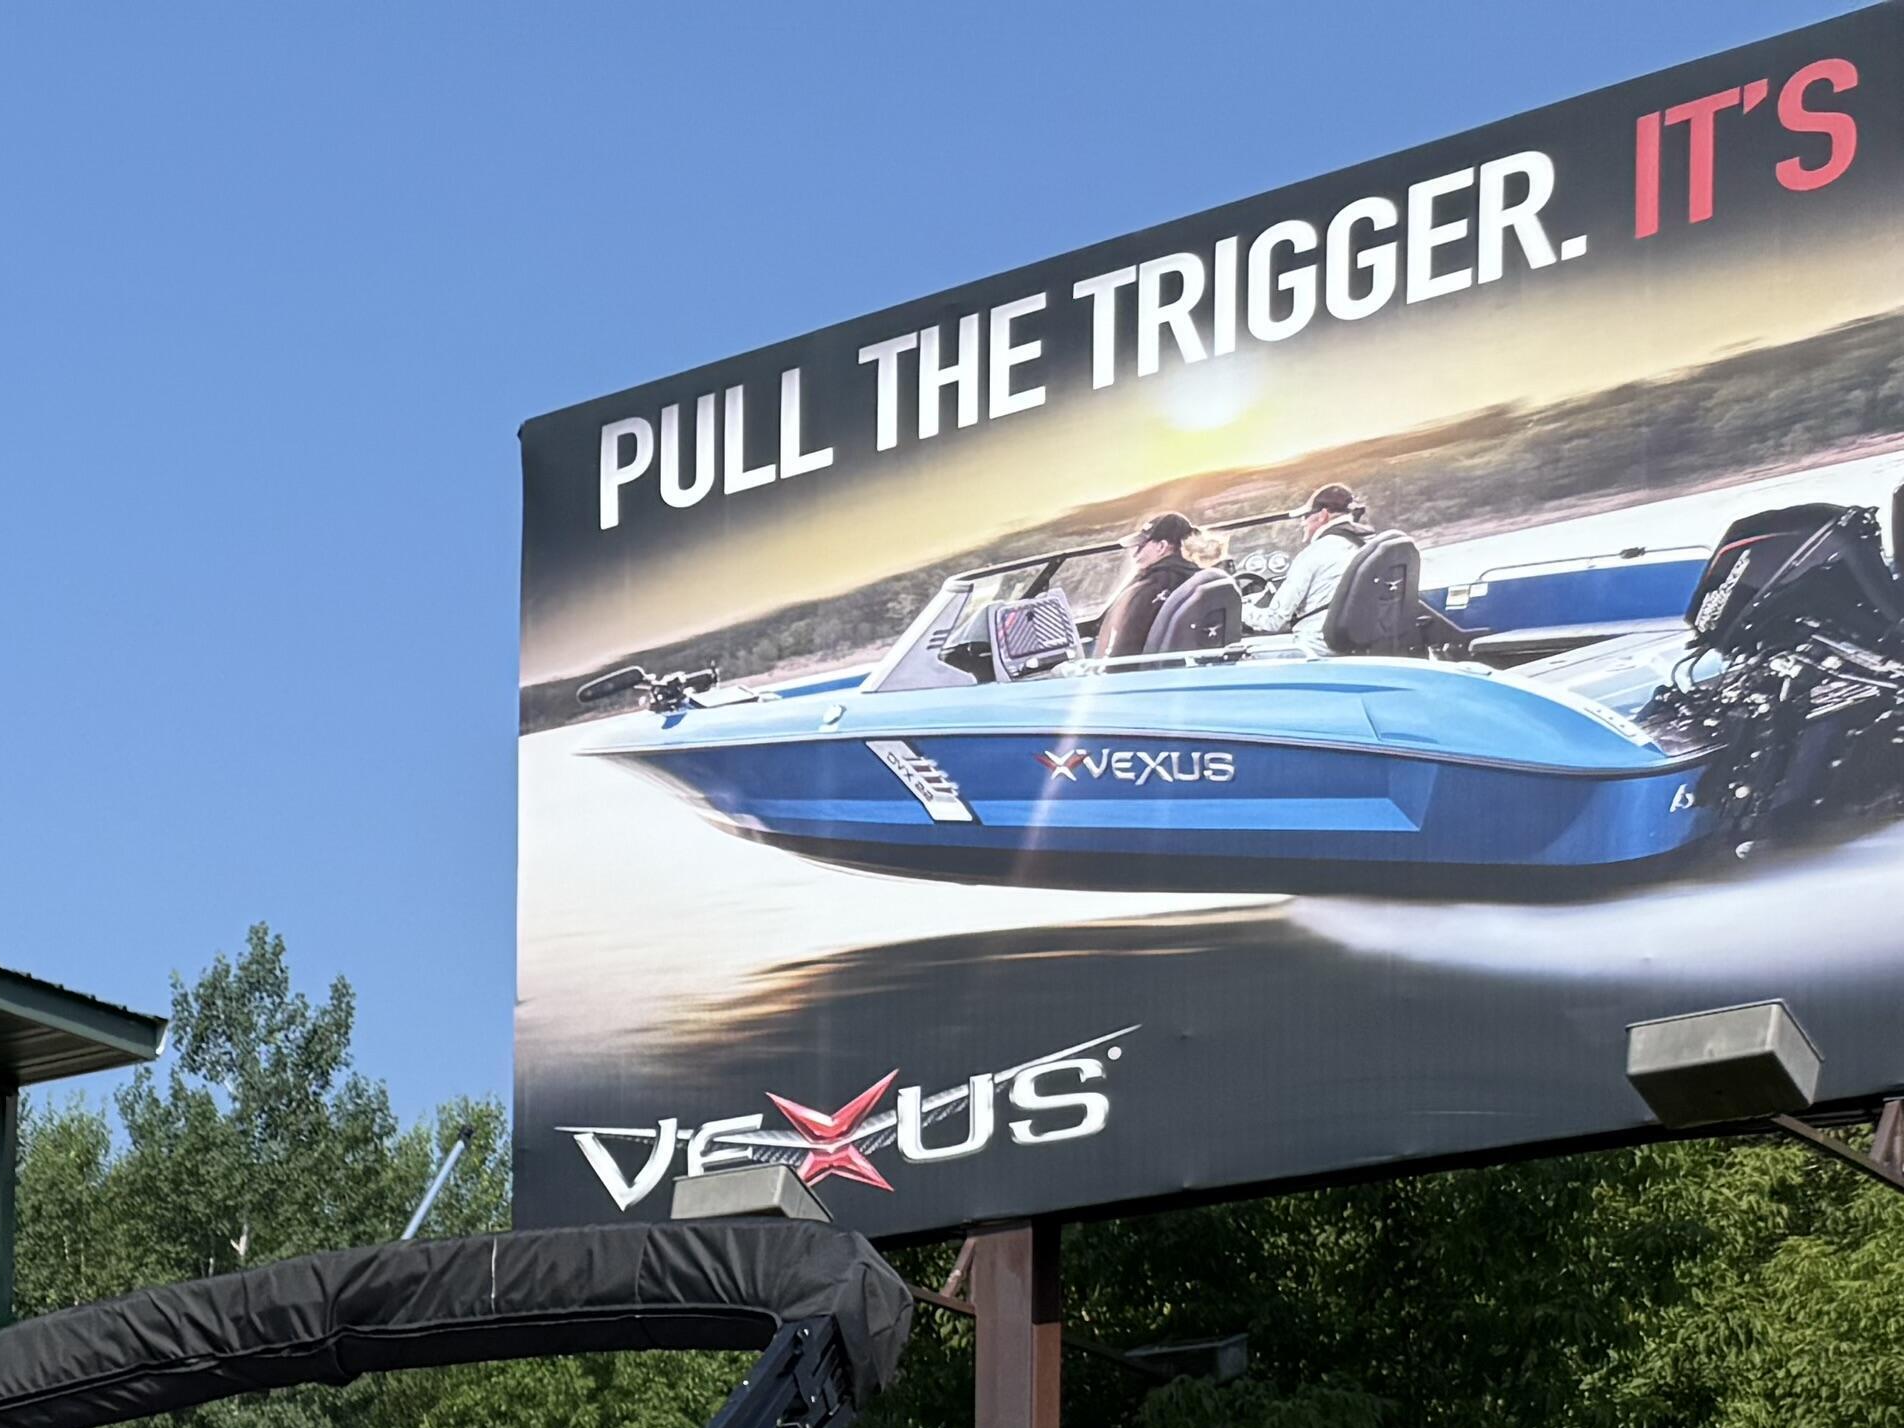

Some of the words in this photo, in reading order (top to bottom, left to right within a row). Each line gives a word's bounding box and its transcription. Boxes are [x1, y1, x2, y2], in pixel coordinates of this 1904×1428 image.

[598, 367, 835, 531] PULL
[858, 292, 1047, 452] THE
[1072, 149, 1588, 392] TRIGGER.
[1633, 57, 1861, 240] IT'S
[1075, 748, 1236, 786] VEXUS
[572, 1057, 1111, 1212] VEXUS
